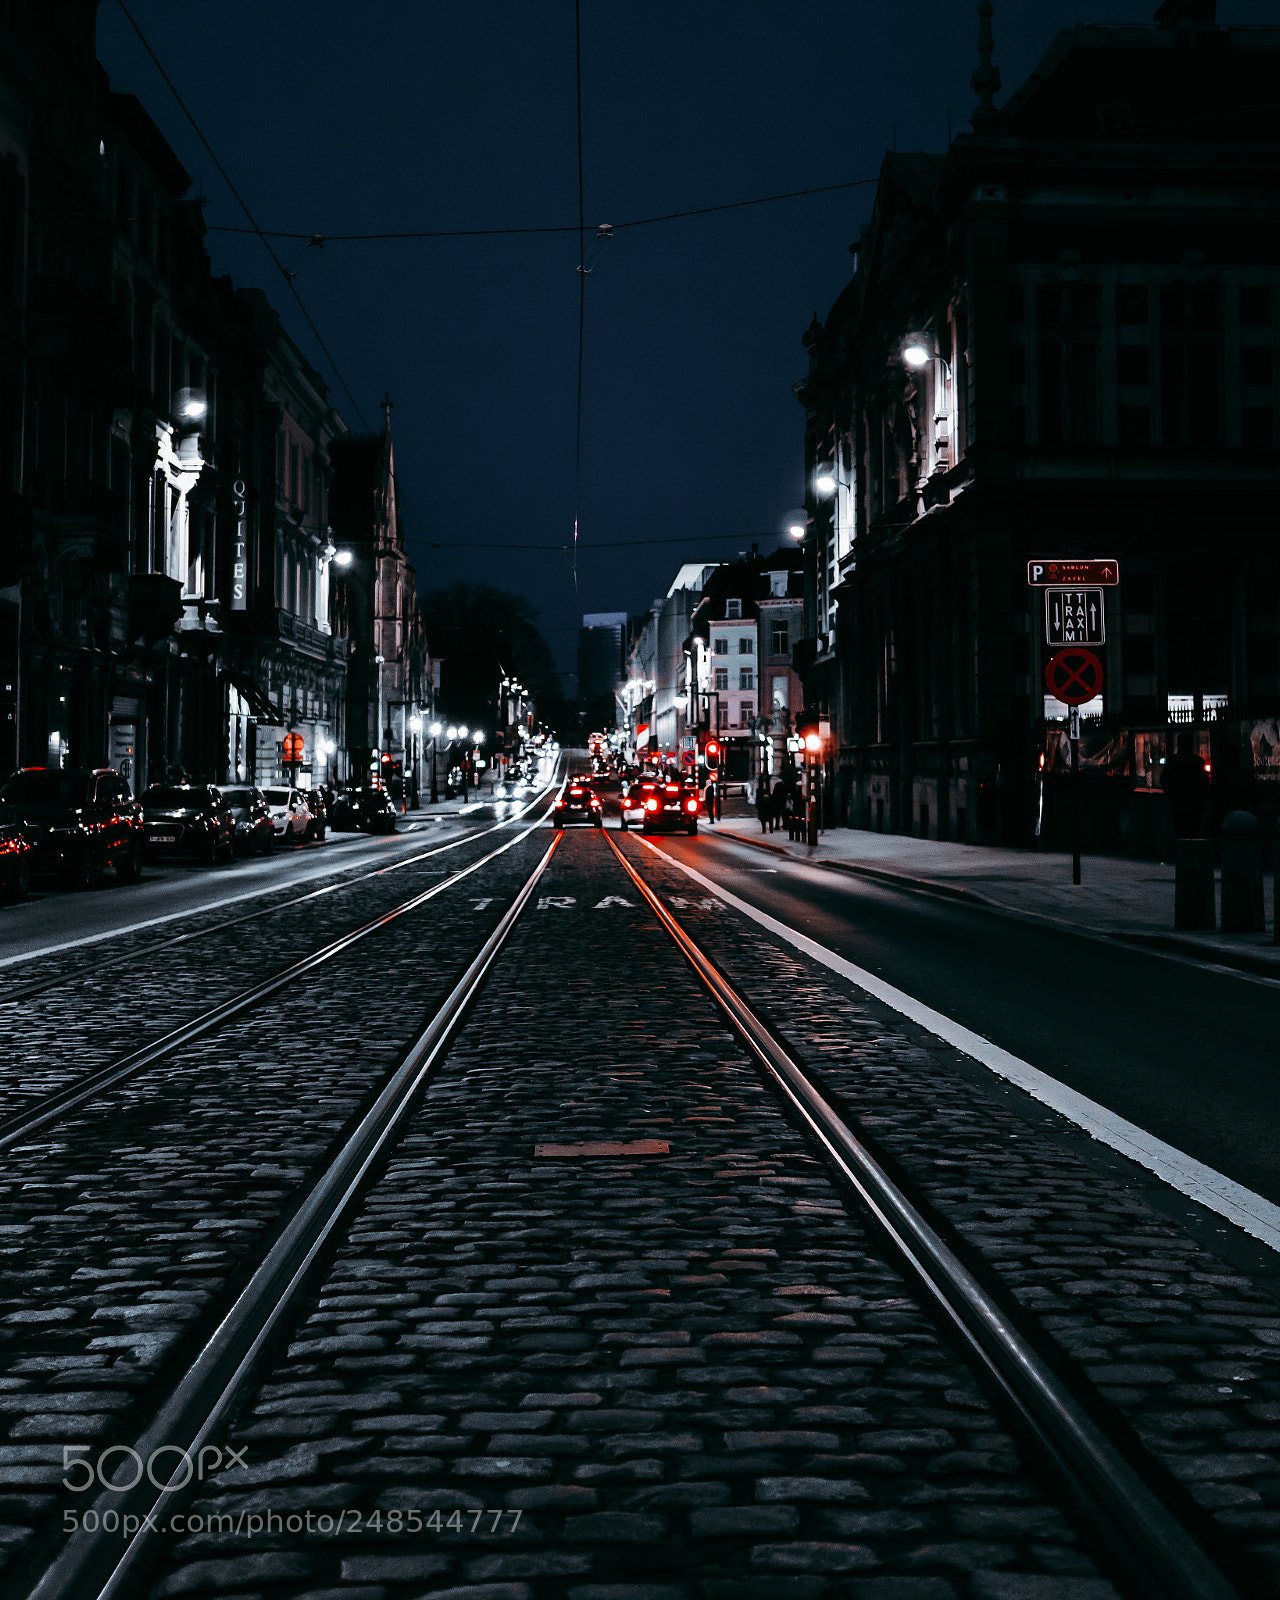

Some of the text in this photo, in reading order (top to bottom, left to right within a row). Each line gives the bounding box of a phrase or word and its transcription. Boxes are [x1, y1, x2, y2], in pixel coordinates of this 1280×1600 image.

[1032, 565, 1044, 582] P
[1065, 593, 1075, 642] TRAM
[1076, 593, 1085, 642] TAXI
